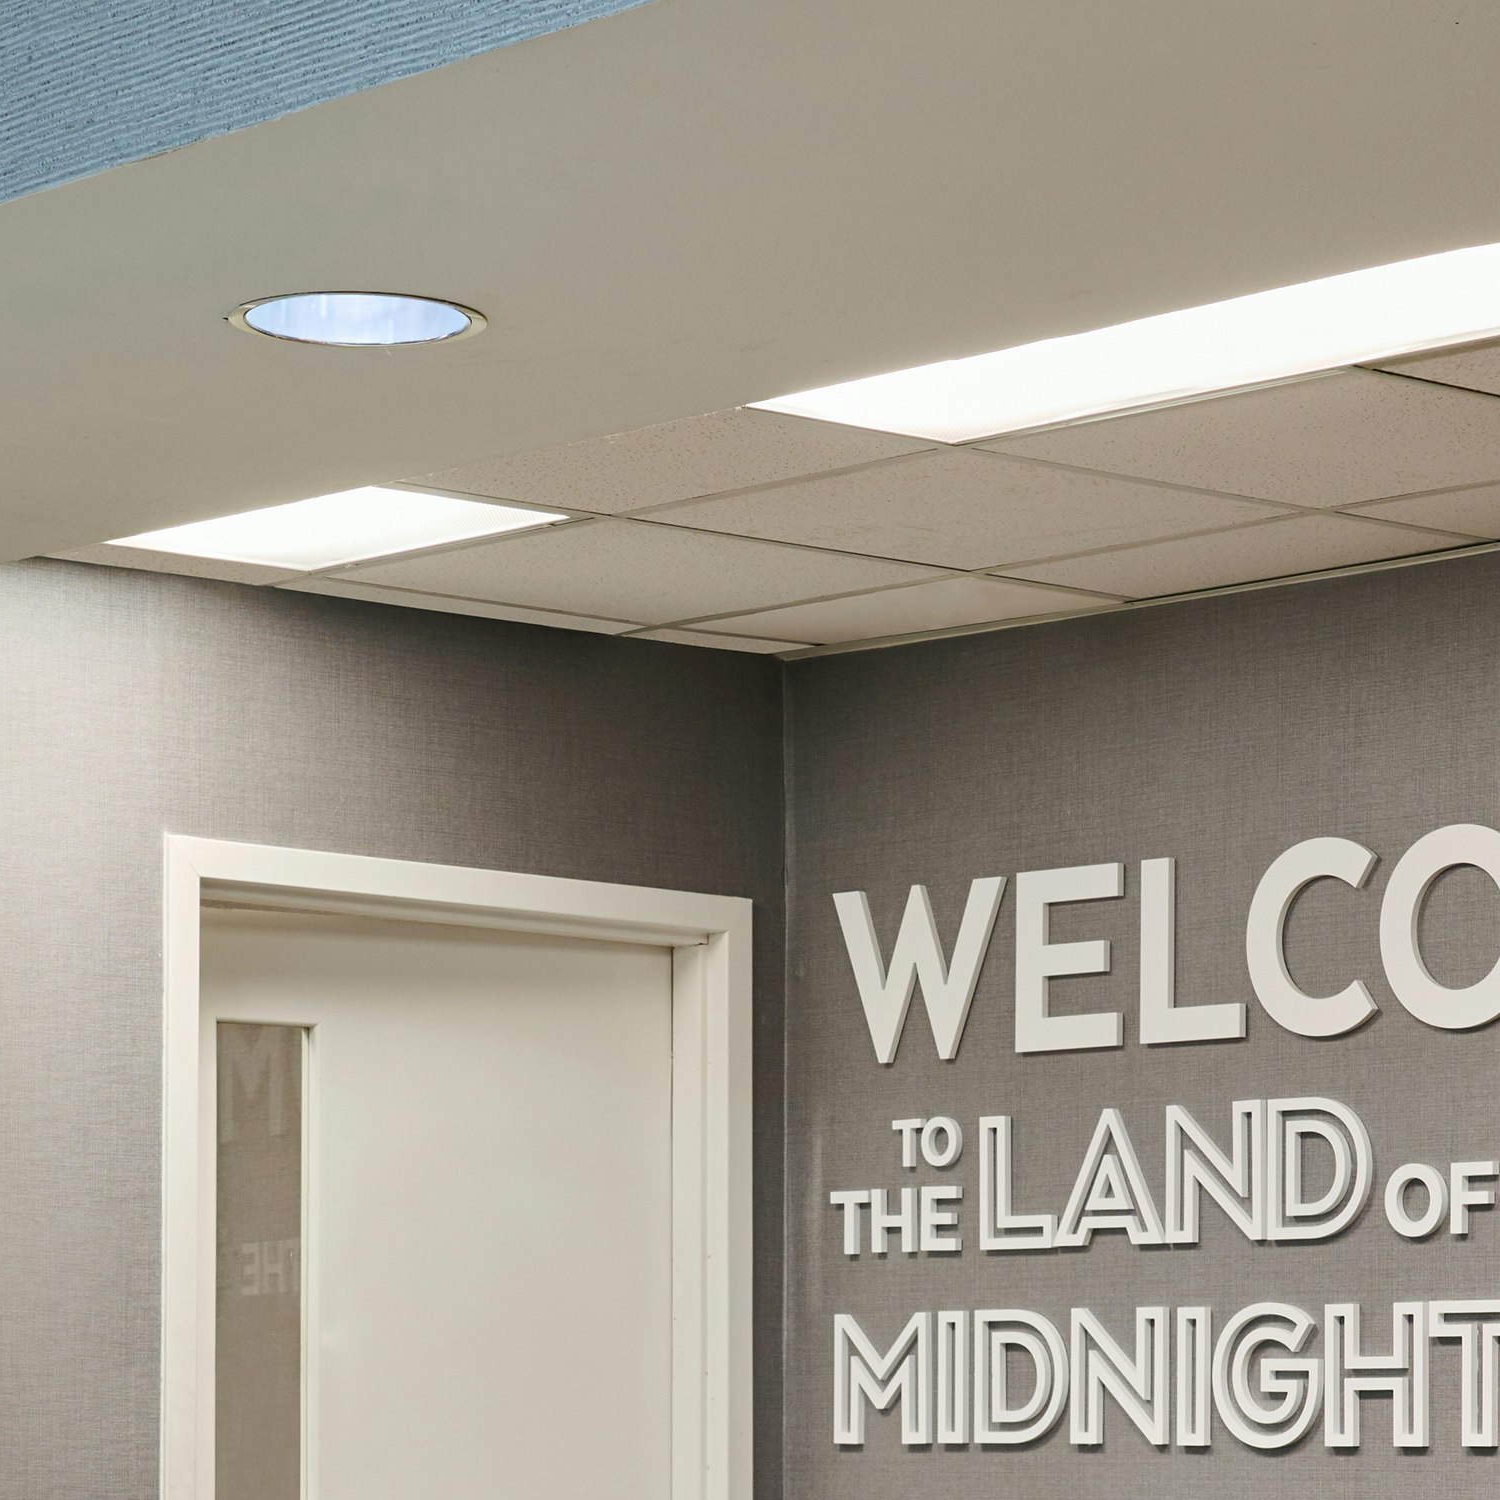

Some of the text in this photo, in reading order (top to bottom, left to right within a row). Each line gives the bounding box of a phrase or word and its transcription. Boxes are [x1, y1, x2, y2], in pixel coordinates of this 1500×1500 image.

[830, 1185, 963, 1255] THE
[979, 1096, 1374, 1251] LAND
[892, 1116, 963, 1168] TO
